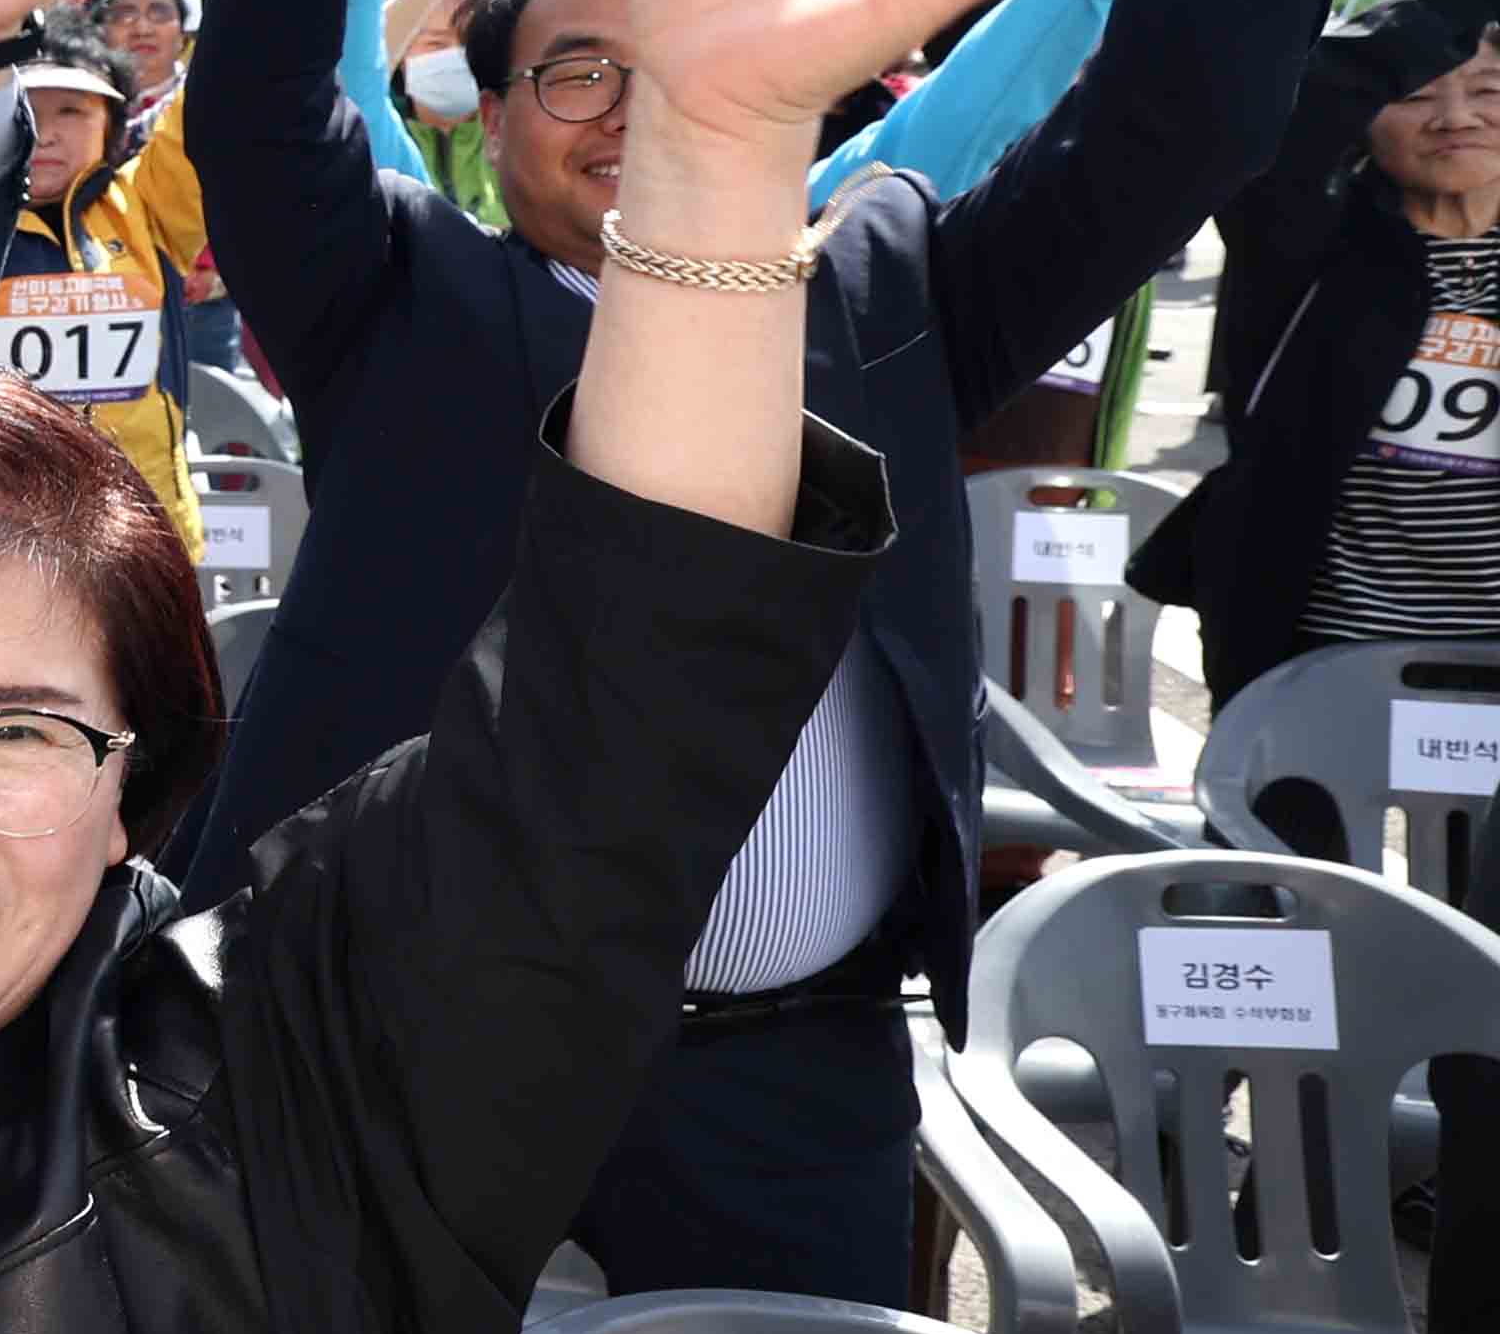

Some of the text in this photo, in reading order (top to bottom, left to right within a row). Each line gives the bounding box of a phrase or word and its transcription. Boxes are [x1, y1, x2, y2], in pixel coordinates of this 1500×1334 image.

[11, 321, 143, 381] 017
[1417, 738, 1498, 763] 내빈석
[1182, 962, 1275, 990] 김경수
